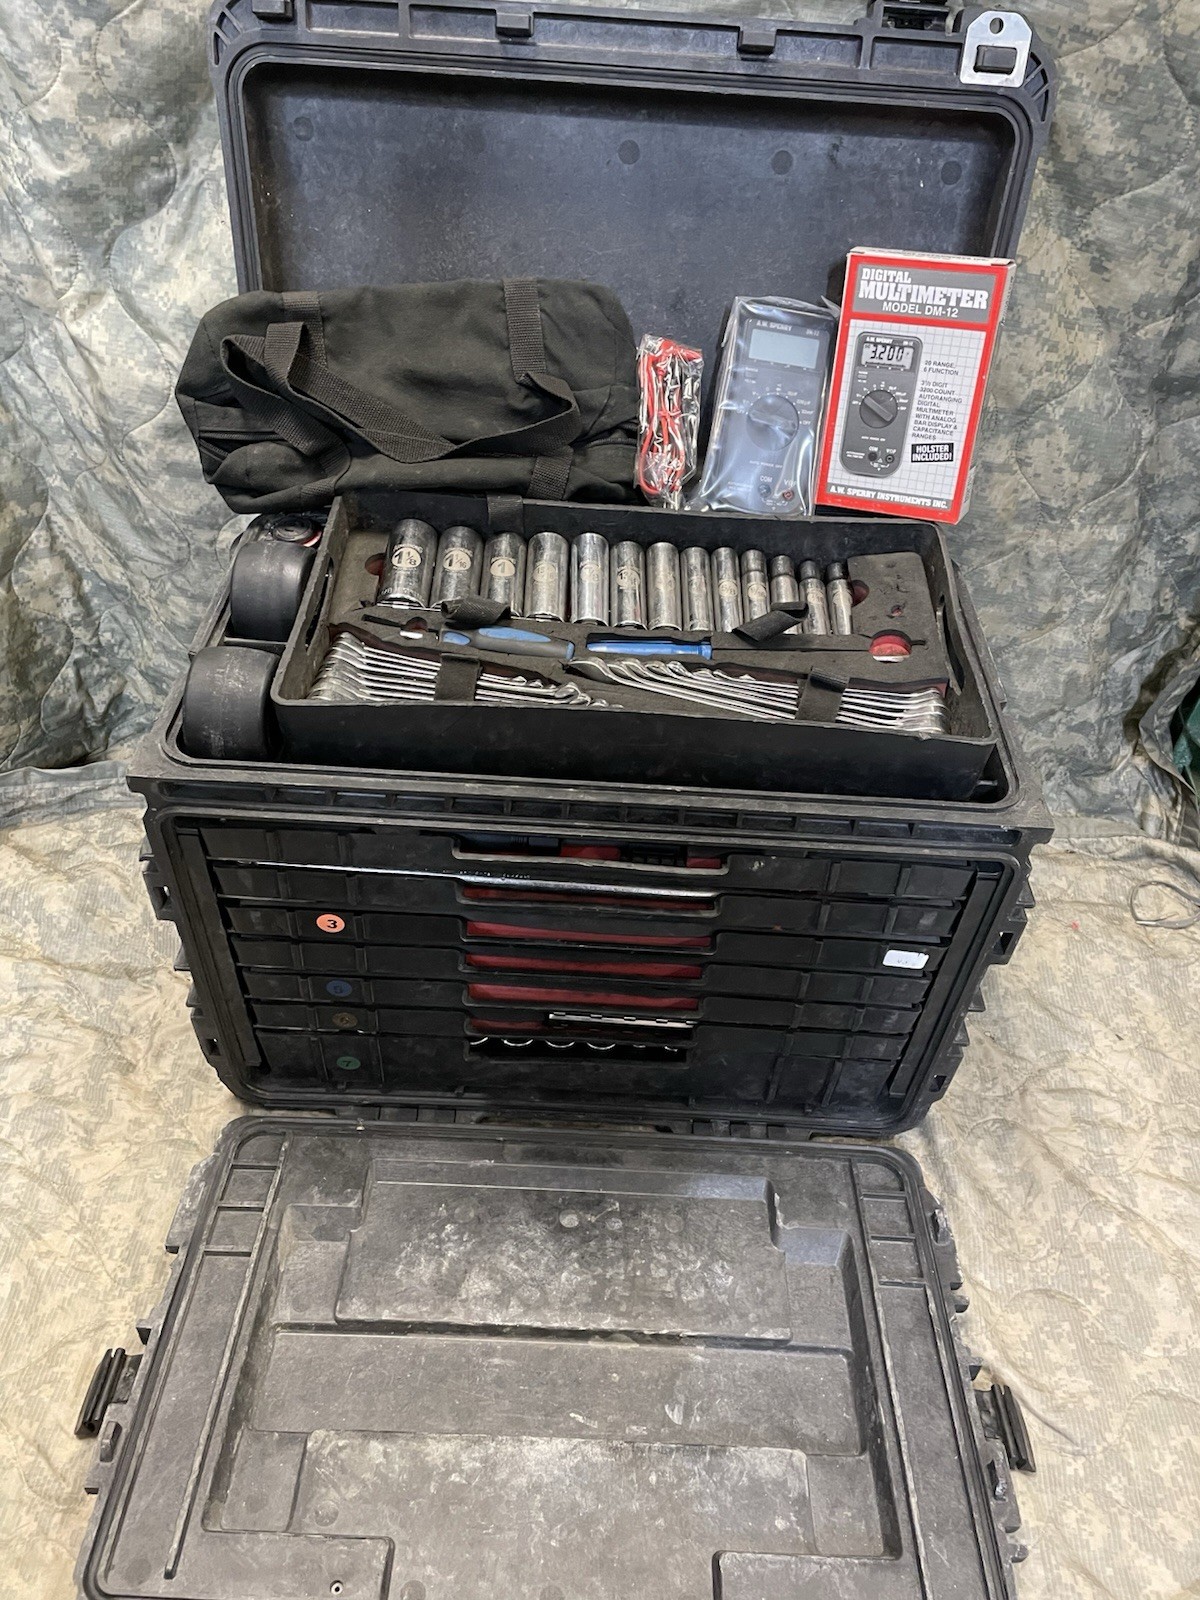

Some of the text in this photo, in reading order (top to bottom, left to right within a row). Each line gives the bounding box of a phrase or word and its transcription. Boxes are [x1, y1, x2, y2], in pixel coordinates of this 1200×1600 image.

[861, 268, 911, 283] DIGITAL
[858, 280, 989, 309] MULTIMETER
[882, 301, 959, 318] MODEL DM-12
[928, 367, 959, 376] FUNCTION
[919, 394, 962, 403] AUTORANGING
[917, 400, 940, 408] DIGITAL
[916, 406, 954, 416] MULTIMETER
[931, 415, 957, 423] ANALOG
[928, 421, 952, 429] DISPLAY
[913, 426, 954, 436] CAPACITANCE
[912, 432, 936, 440] RANGES
[916, 445, 949, 453] HOLSTER
[912, 452, 952, 461] INCLUDED!
[830, 485, 948, 509] A.W. SPERRY INSTRUMENTS INC.
[327, 919, 338, 928] 3
